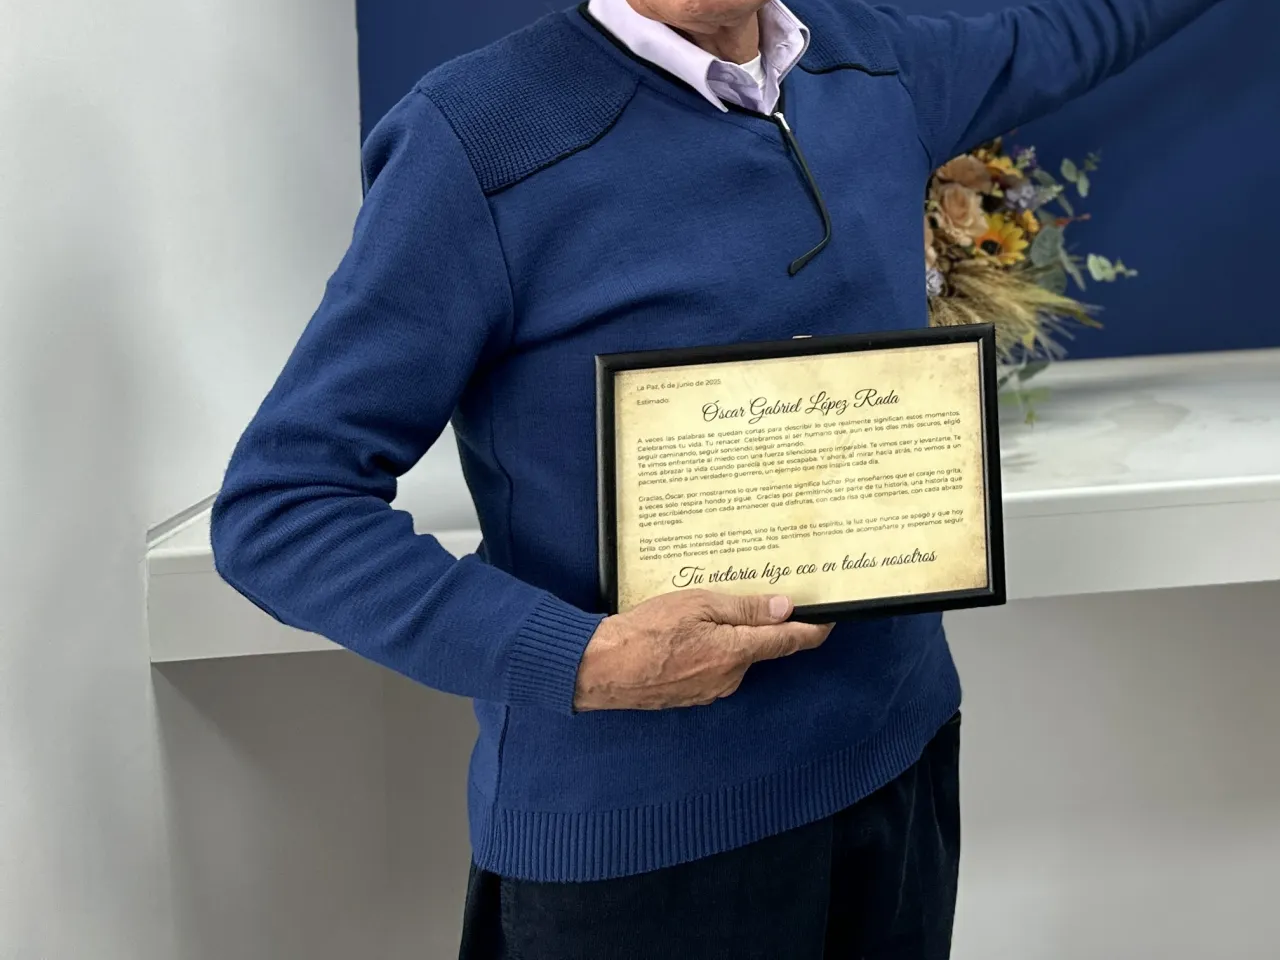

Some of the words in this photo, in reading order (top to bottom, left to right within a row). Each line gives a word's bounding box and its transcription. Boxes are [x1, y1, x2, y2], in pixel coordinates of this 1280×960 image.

[702, 400, 744, 422] Óscar
[748, 397, 802, 424] Gabriel
[804, 390, 848, 416] López
[853, 388, 899, 408] Rada
[637, 443, 676, 452] Celebramos
[744, 434, 782, 443] Celebramos
[943, 418, 960, 426] eligió
[677, 432, 705, 441] palabras
[717, 429, 742, 437] quedan
[784, 423, 812, 431] describir
[838, 418, 871, 426] realmente
[873, 415, 903, 424] significan
[637, 453, 657, 461] seguir
[698, 448, 718, 456] seguir
[754, 443, 774, 451] seguir
[668, 457, 705, 466] enfrentarte
[764, 450, 784, 458] fuerza
[659, 467, 683, 475] abrazar
[709, 463, 734, 471] cuando
[699, 471, 732, 480] verdadero
[774, 465, 801, 474] ejemplo
[680, 499, 702, 507] respira
[756, 492, 780, 500] Gracias
[924, 476, 948, 484] historia
[699, 488, 736, 497] mostrarnos
[759, 483, 792, 491] realmente
[794, 480, 820, 489] significa
[857, 473, 893, 482] enseñarnos
[916, 469, 935, 477] coraje
[638, 512, 656, 520] sigue
[658, 507, 702, 517] escribiéndose
[736, 502, 768, 510] amanecer
[639, 537, 652, 545] Hoy
[654, 534, 692, 543] celebramos
[777, 524, 797, 532] fuerza
[910, 511, 930, 519] apagó
[951, 508, 963, 516] hoy
[689, 539, 724, 548] intensidad
[780, 531, 810, 540] sentimos
[907, 519, 942, 528] esperamos
[944, 516, 963, 525] seguir
[639, 553, 662, 561] viendo
[683, 548, 708, 556] floreces
[672, 566, 705, 587] Tu
[708, 565, 758, 583] victoria
[761, 562, 791, 584] hizo
[796, 563, 817, 574] eco
[822, 562, 836, 572] en
[842, 552, 876, 570] todos
[881, 548, 936, 566] nosotros
